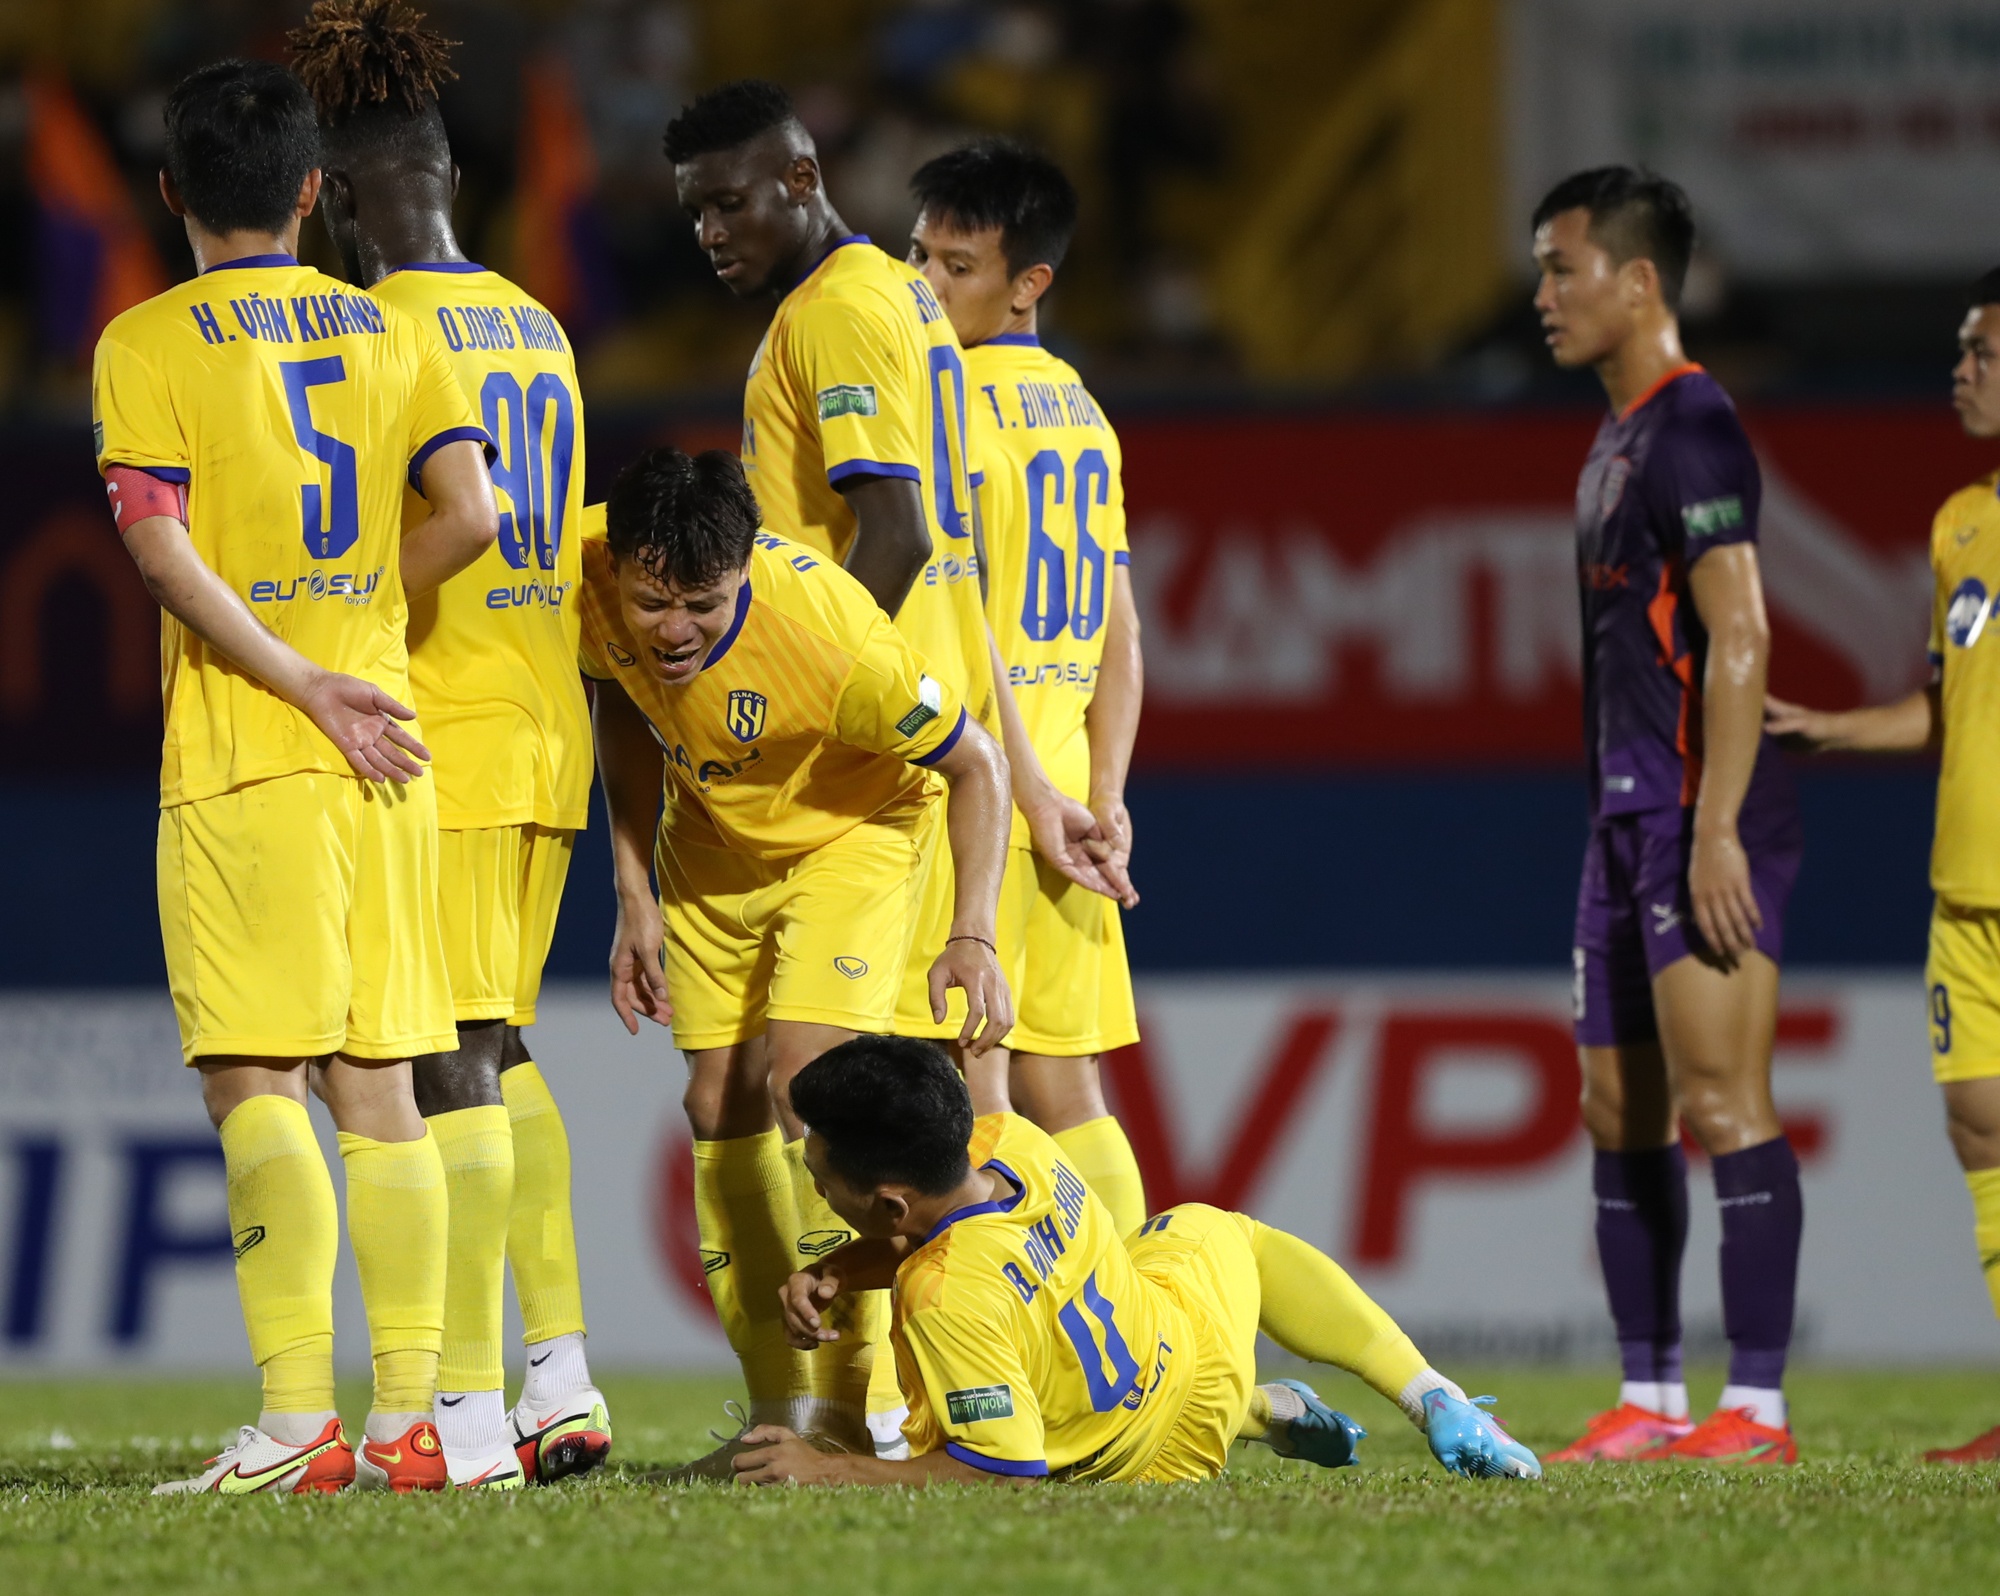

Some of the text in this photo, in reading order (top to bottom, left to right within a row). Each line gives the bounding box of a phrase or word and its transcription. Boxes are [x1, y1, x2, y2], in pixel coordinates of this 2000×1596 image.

[190, 288, 386, 345] H. VĂN KHÁNH
[981, 384, 1017, 430] T.
[278, 355, 359, 559] 5
[480, 371, 575, 570] 90
[1020, 449, 1110, 641] 66
[901, 708, 929, 733] NIGHT
[1002, 1262, 1039, 1305] B.
[979, 1396, 1008, 1413] WOLF
[300, 1445, 331, 1466] TIEMPO
